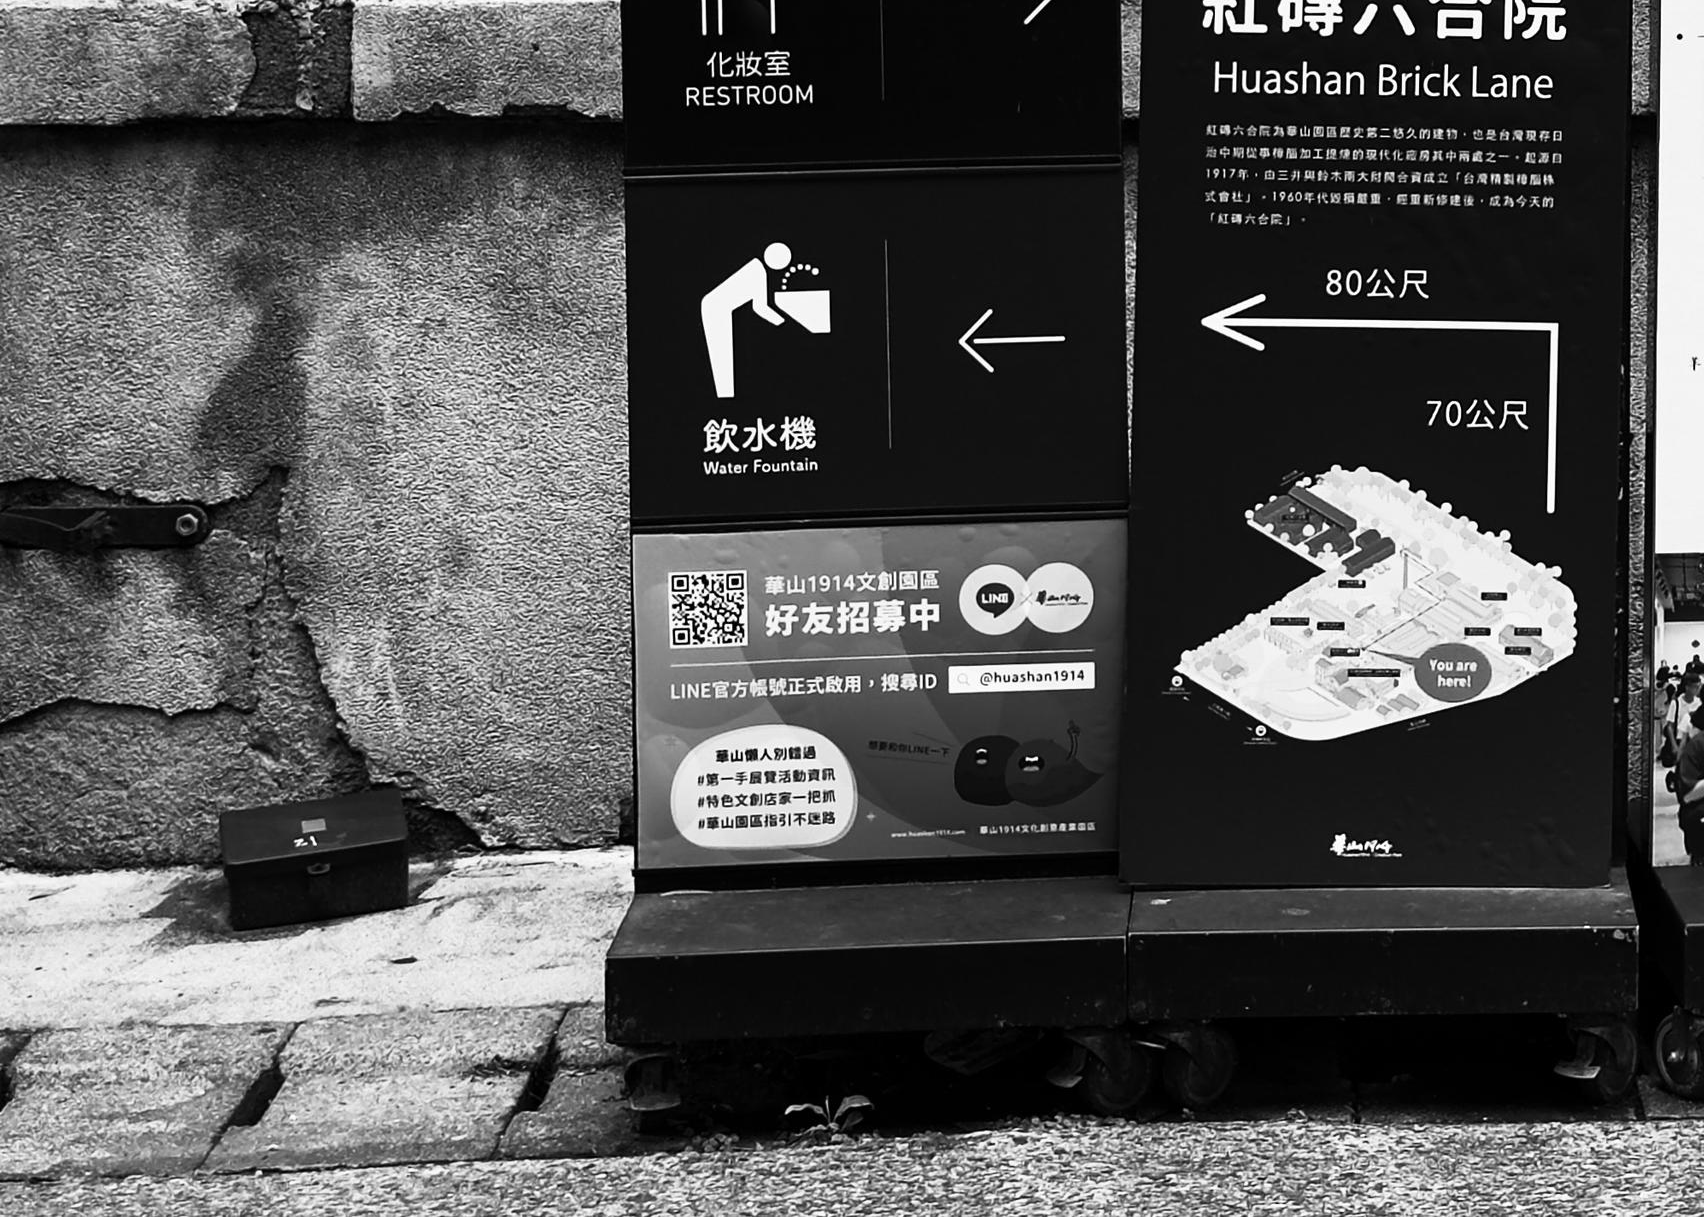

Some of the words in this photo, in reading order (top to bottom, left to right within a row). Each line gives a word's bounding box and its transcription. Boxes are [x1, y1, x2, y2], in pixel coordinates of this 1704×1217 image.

[706, 50, 791, 78] 化妝室
[1214, 60, 1365, 96] Huashan
[1378, 63, 1462, 97] Brick
[1471, 65, 1554, 99] Lane
[685, 84, 814, 107] RESTROOM
[1325, 268, 1430, 299] 80公尺
[1426, 399, 1529, 431] 70公尺
[703, 415, 817, 454] 飲水機
[703, 460, 749, 475] Water
[753, 457, 819, 474] Fountain
[764, 568, 940, 598] 華山1914文創園區
[981, 592, 1009, 605] LINE
[764, 598, 942, 637] 好友招募中
[1429, 659, 1454, 672] You
[1455, 661, 1478, 672] are
[979, 669, 1085, 687] @huashan1914
[1437, 674, 1471, 688] here!
[697, 789, 836, 809] #特色文創店家一把抓
[698, 810, 836, 830] #華山園區指引不迷路
